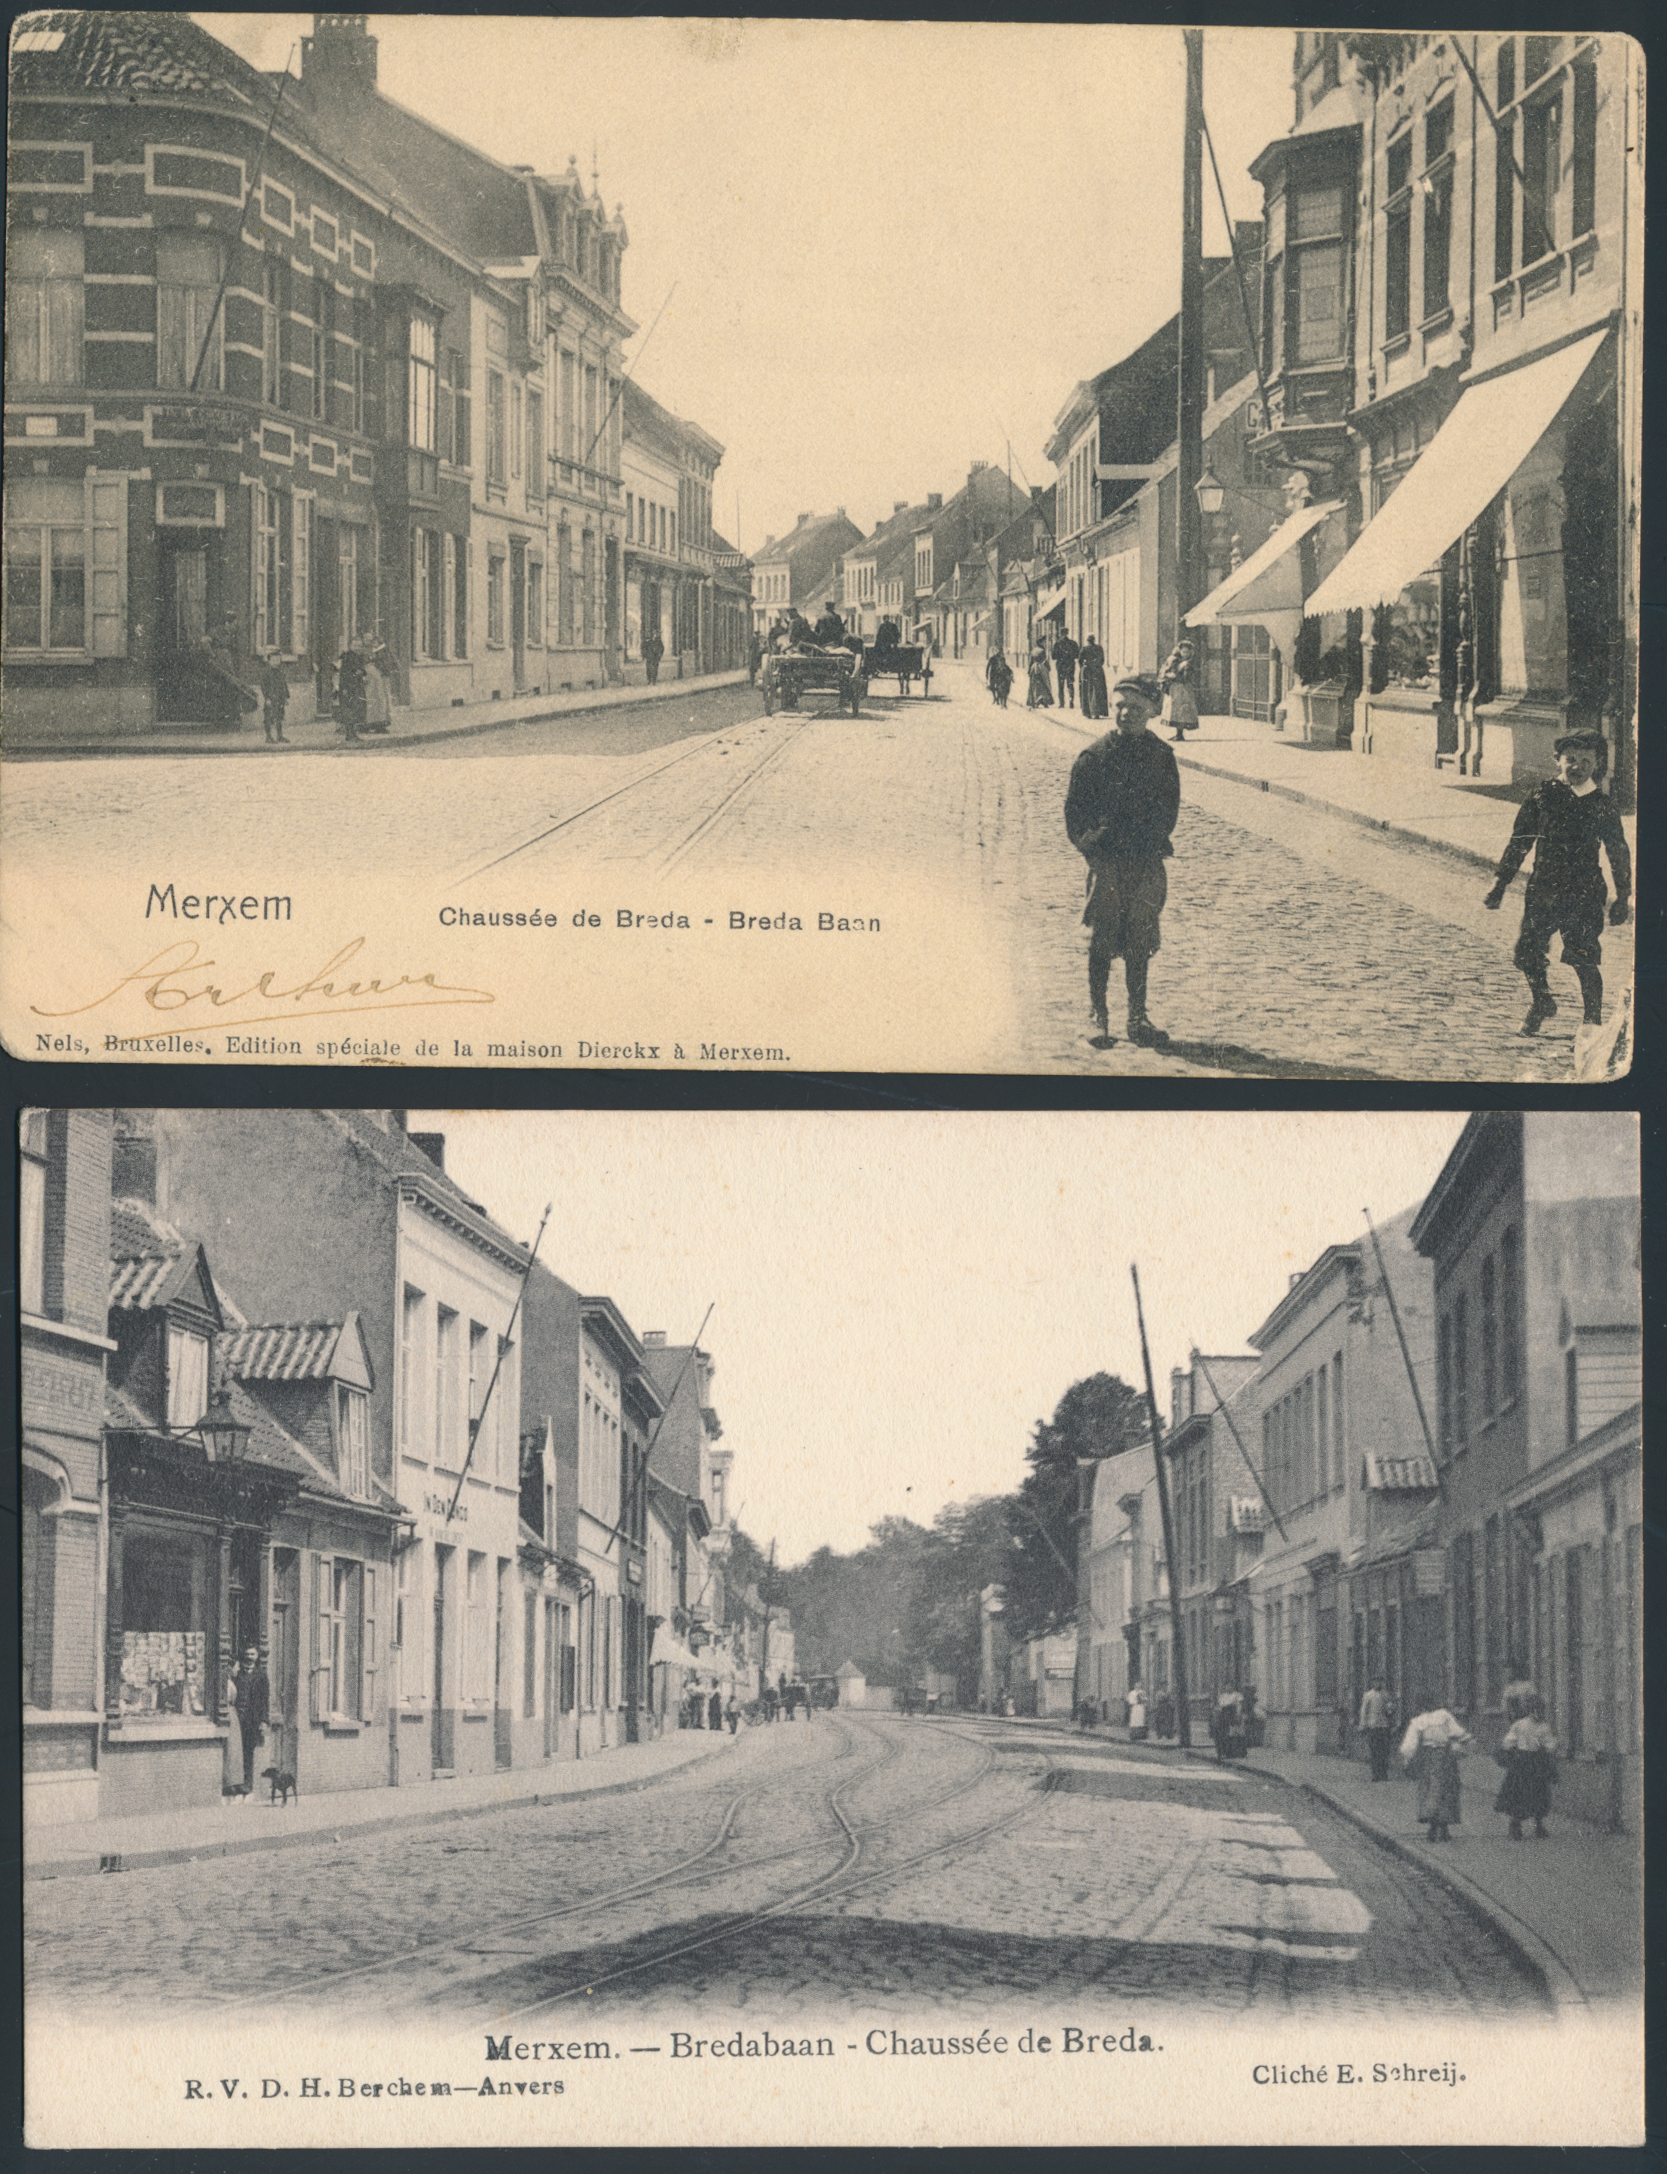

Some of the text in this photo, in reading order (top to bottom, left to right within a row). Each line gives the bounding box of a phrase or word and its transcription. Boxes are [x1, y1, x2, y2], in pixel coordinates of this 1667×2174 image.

[146, 883, 292, 925] Merxem
[439, 906, 558, 928] Chaussée
[572, 909, 602, 928] de
[616, 909, 691, 930] Breda
[729, 911, 803, 931] Breda
[818, 912, 881, 932] Baan
[36, 1034, 90, 1056] Nels,
[226, 1037, 302, 1056] Edition
[316, 1037, 402, 1061] spéciale
[415, 1039, 440, 1056] de
[454, 1039, 474, 1057] la
[487, 1040, 563, 1058] maison
[577, 1041, 661, 1059] Dierckx
[674, 1043, 687, 1060] à
[699, 1043, 792, 1061] Merxem.
[485, 2035, 622, 2061] Merxem.
[670, 2031, 834, 2058] Bredabaan
[865, 2029, 1009, 2056] Chaussée
[1018, 2029, 1052, 2053] de
[1062, 2029, 1165, 2053] Breda.
[1253, 2064, 1328, 2085] Cliché
[1337, 2064, 1364, 2084] E.
[185, 2080, 212, 2100] R.
[220, 2079, 247, 2099] V.
[261, 2079, 289, 2098] D.
